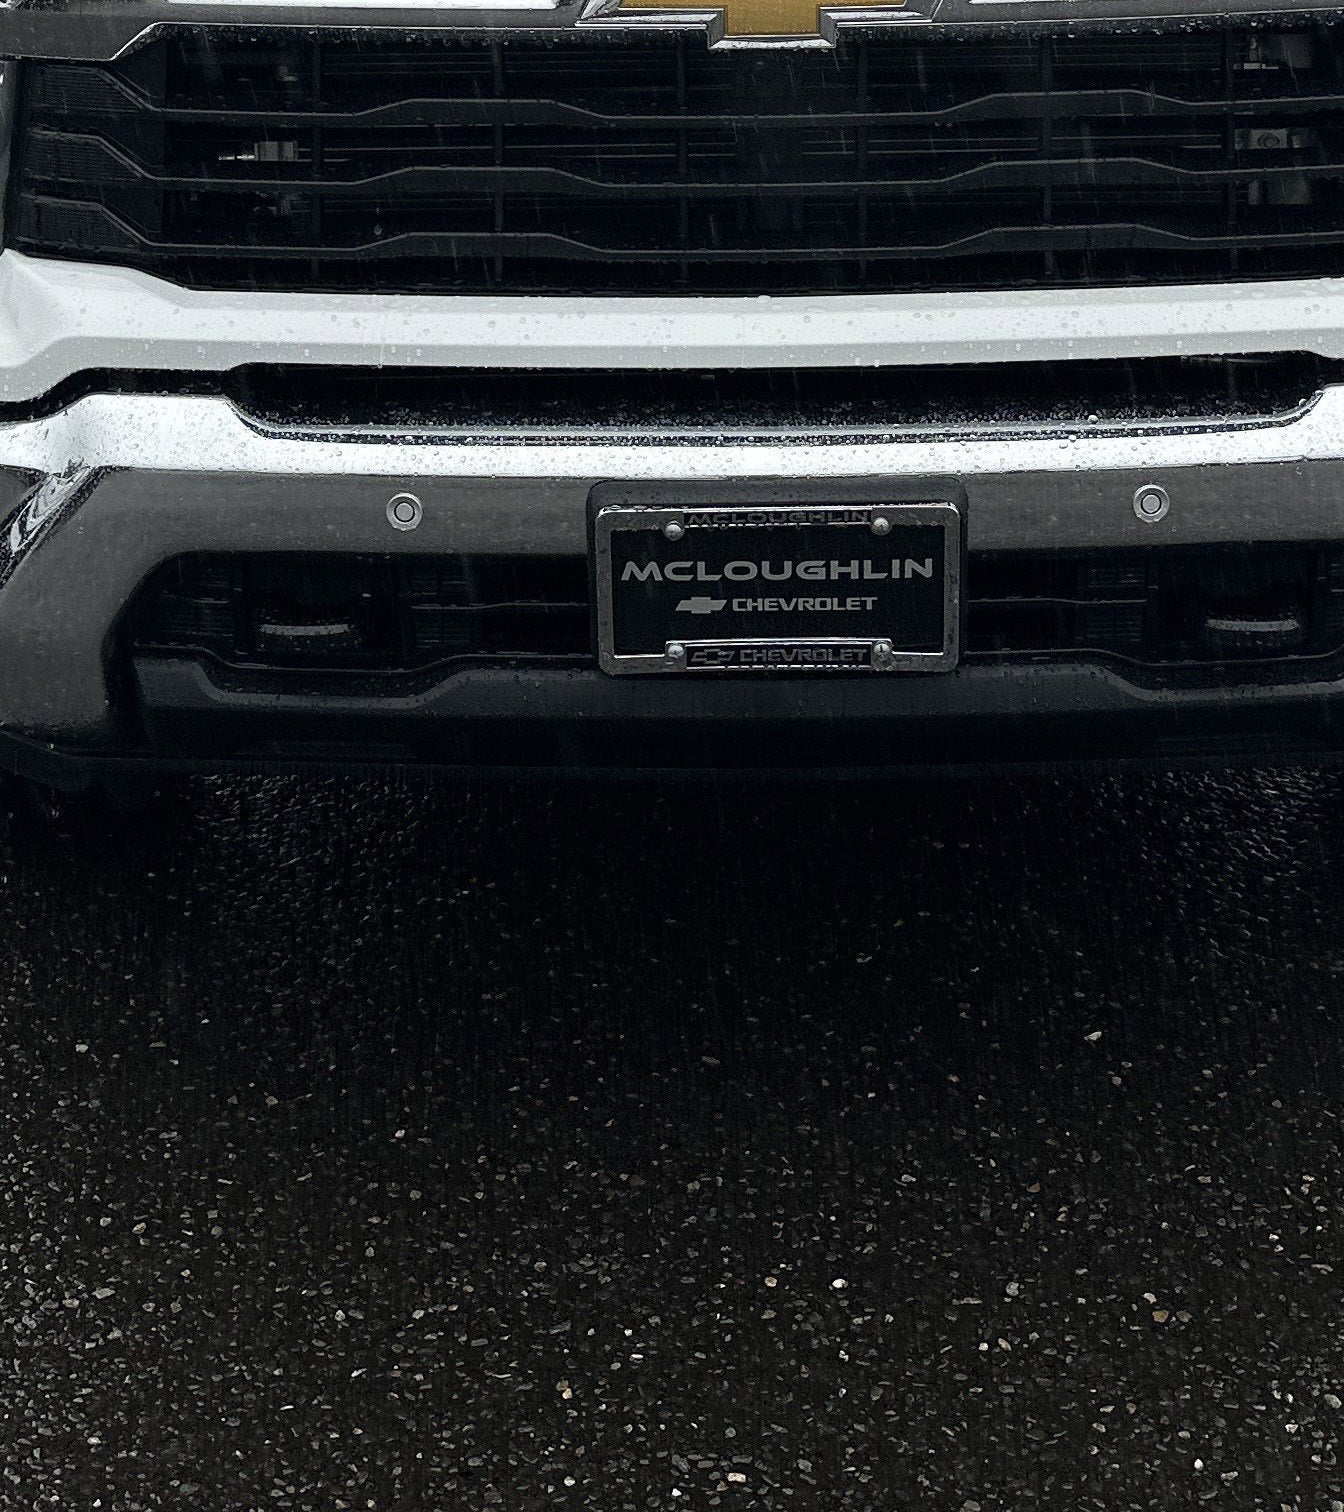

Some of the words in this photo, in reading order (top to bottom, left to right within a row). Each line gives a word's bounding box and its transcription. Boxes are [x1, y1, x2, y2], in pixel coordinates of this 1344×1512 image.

[688, 510, 868, 524] MCLOUGHLIN
[621, 558, 933, 582] MCLOUGHLIN
[732, 596, 878, 611] CHEVROLET
[740, 648, 868, 663] CHEVROLET
